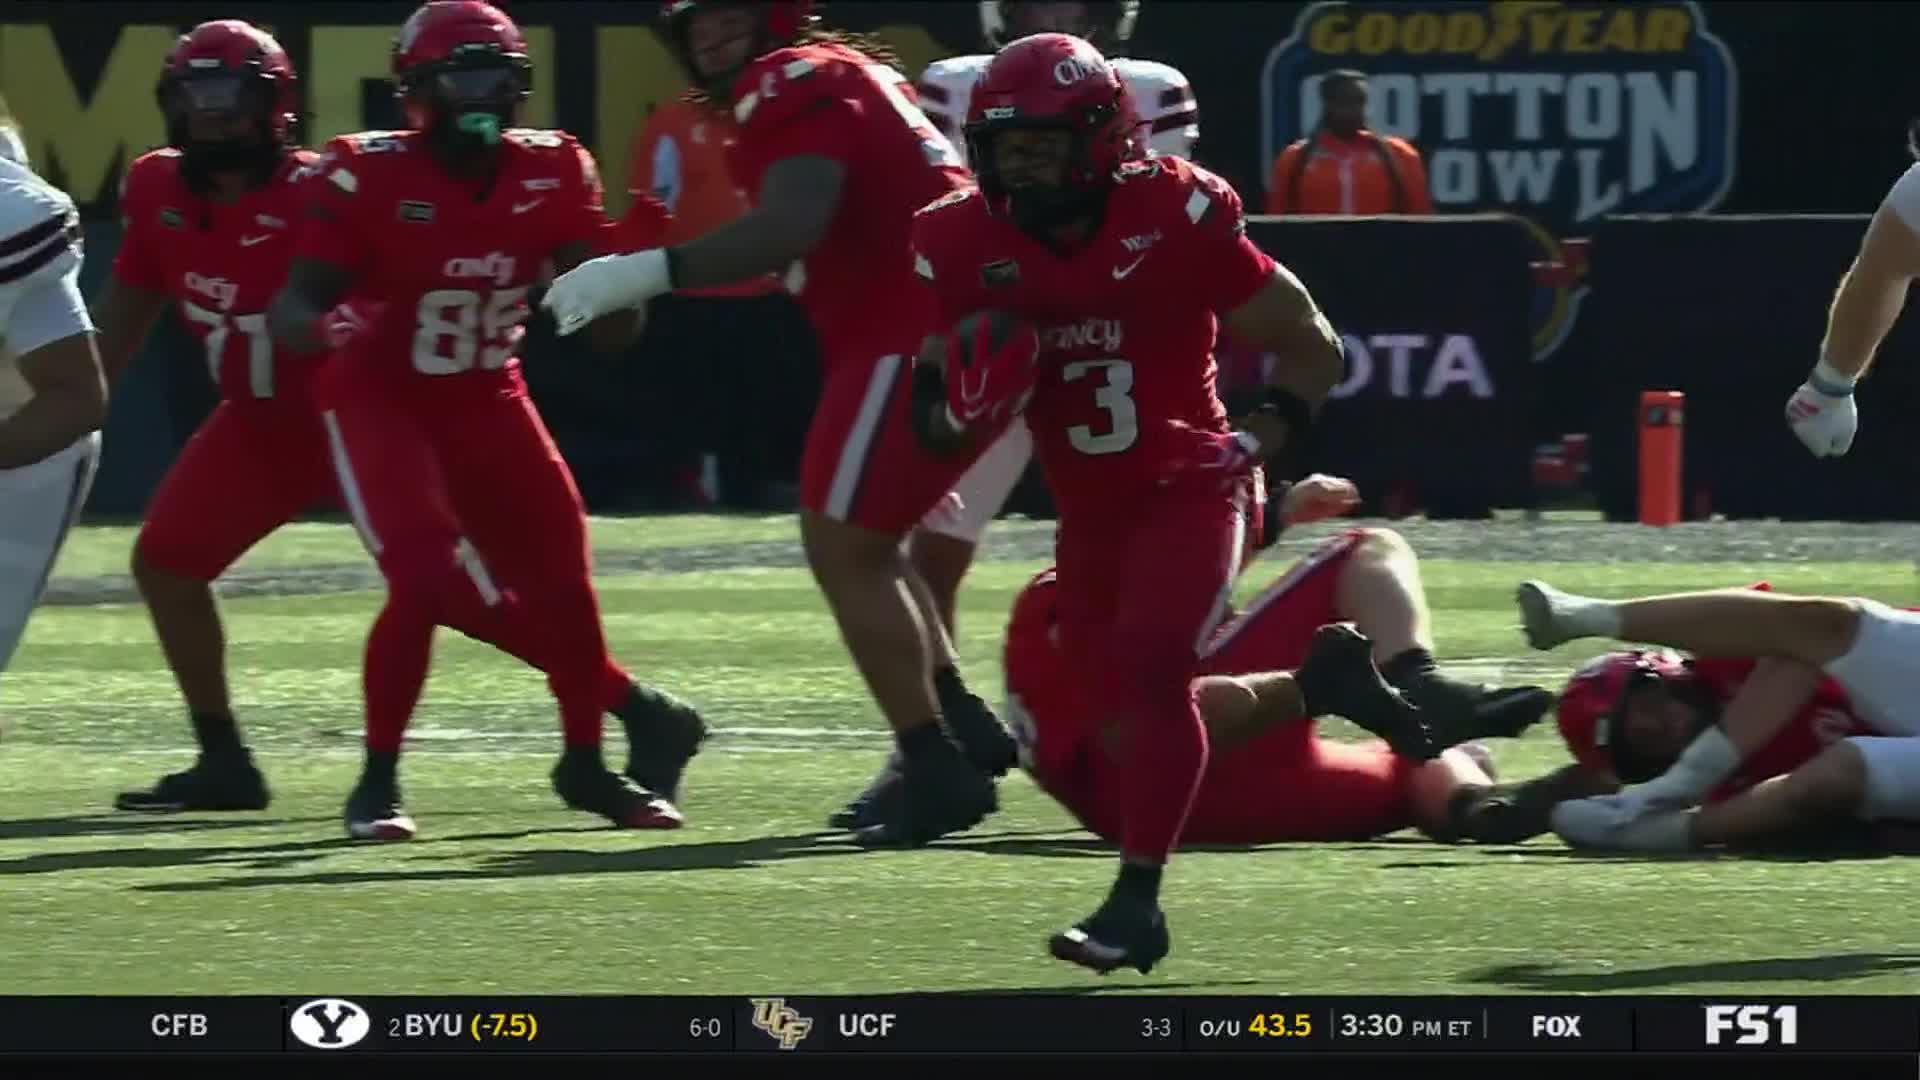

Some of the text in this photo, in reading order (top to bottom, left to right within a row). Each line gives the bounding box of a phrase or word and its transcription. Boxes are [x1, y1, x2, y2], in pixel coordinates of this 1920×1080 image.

[1311, 7, 1691, 55] GOODYEAR
[1431, 149, 1622, 223] OWL
[183, 300, 274, 399] 71
[410, 287, 530, 376] 85
[1327, 333, 1493, 398] OTA
[1062, 358, 1140, 456] 3
